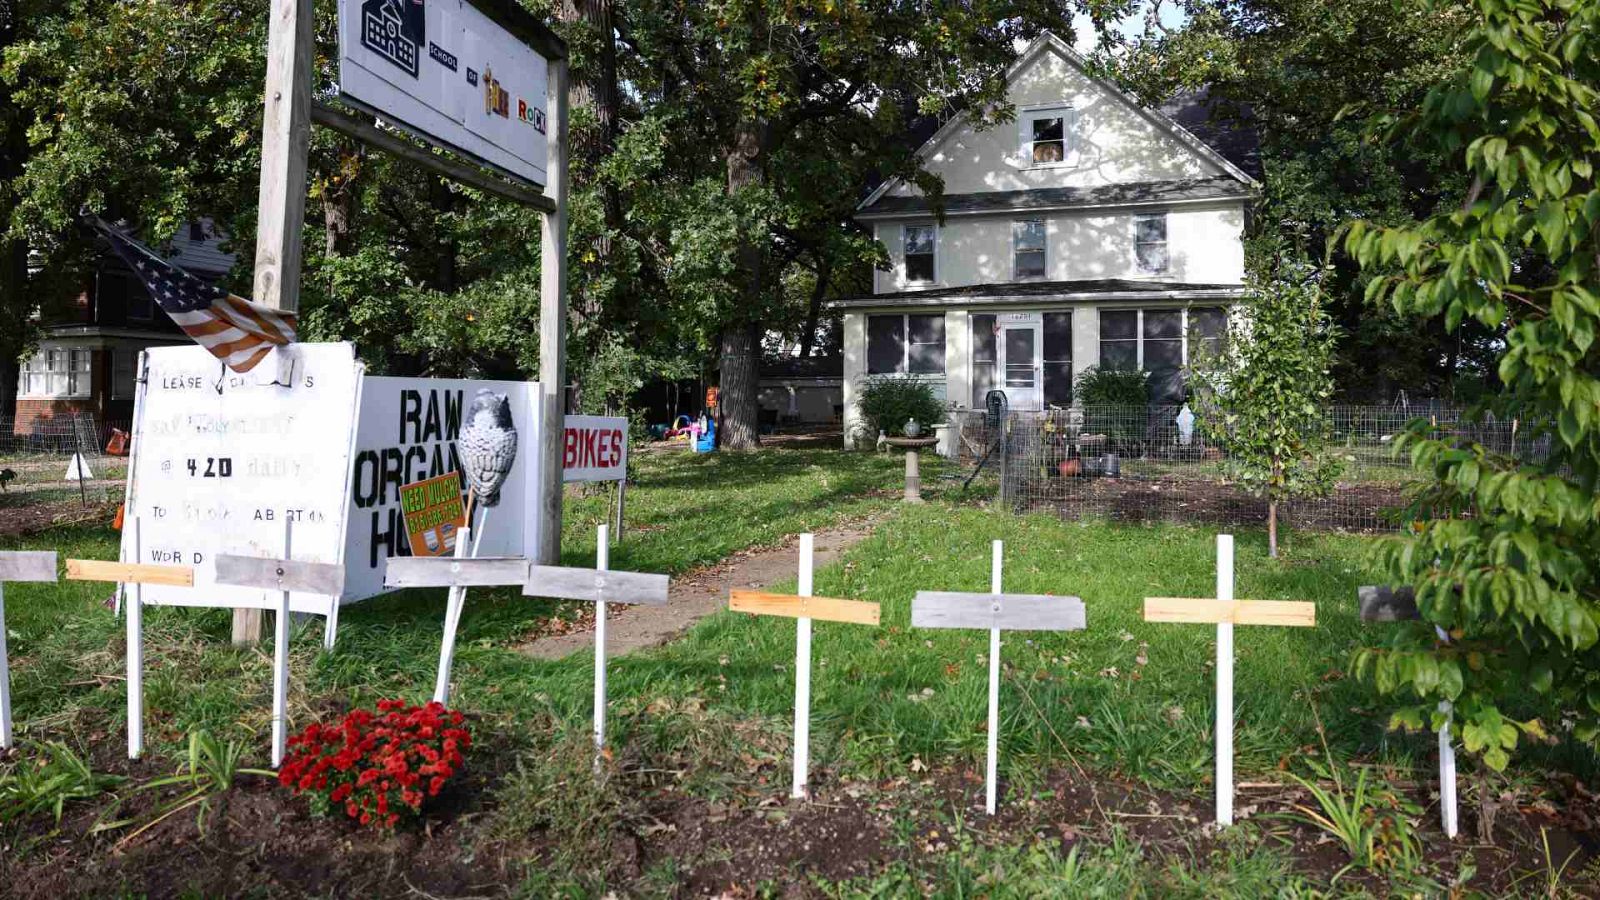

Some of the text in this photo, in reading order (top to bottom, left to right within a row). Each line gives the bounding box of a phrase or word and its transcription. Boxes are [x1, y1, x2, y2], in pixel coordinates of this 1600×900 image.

[430, 43, 457, 71] SCHOOL
[400, 389, 464, 444] RAW
[562, 428, 623, 468] BIKES
[187, 457, 232, 478] 420
